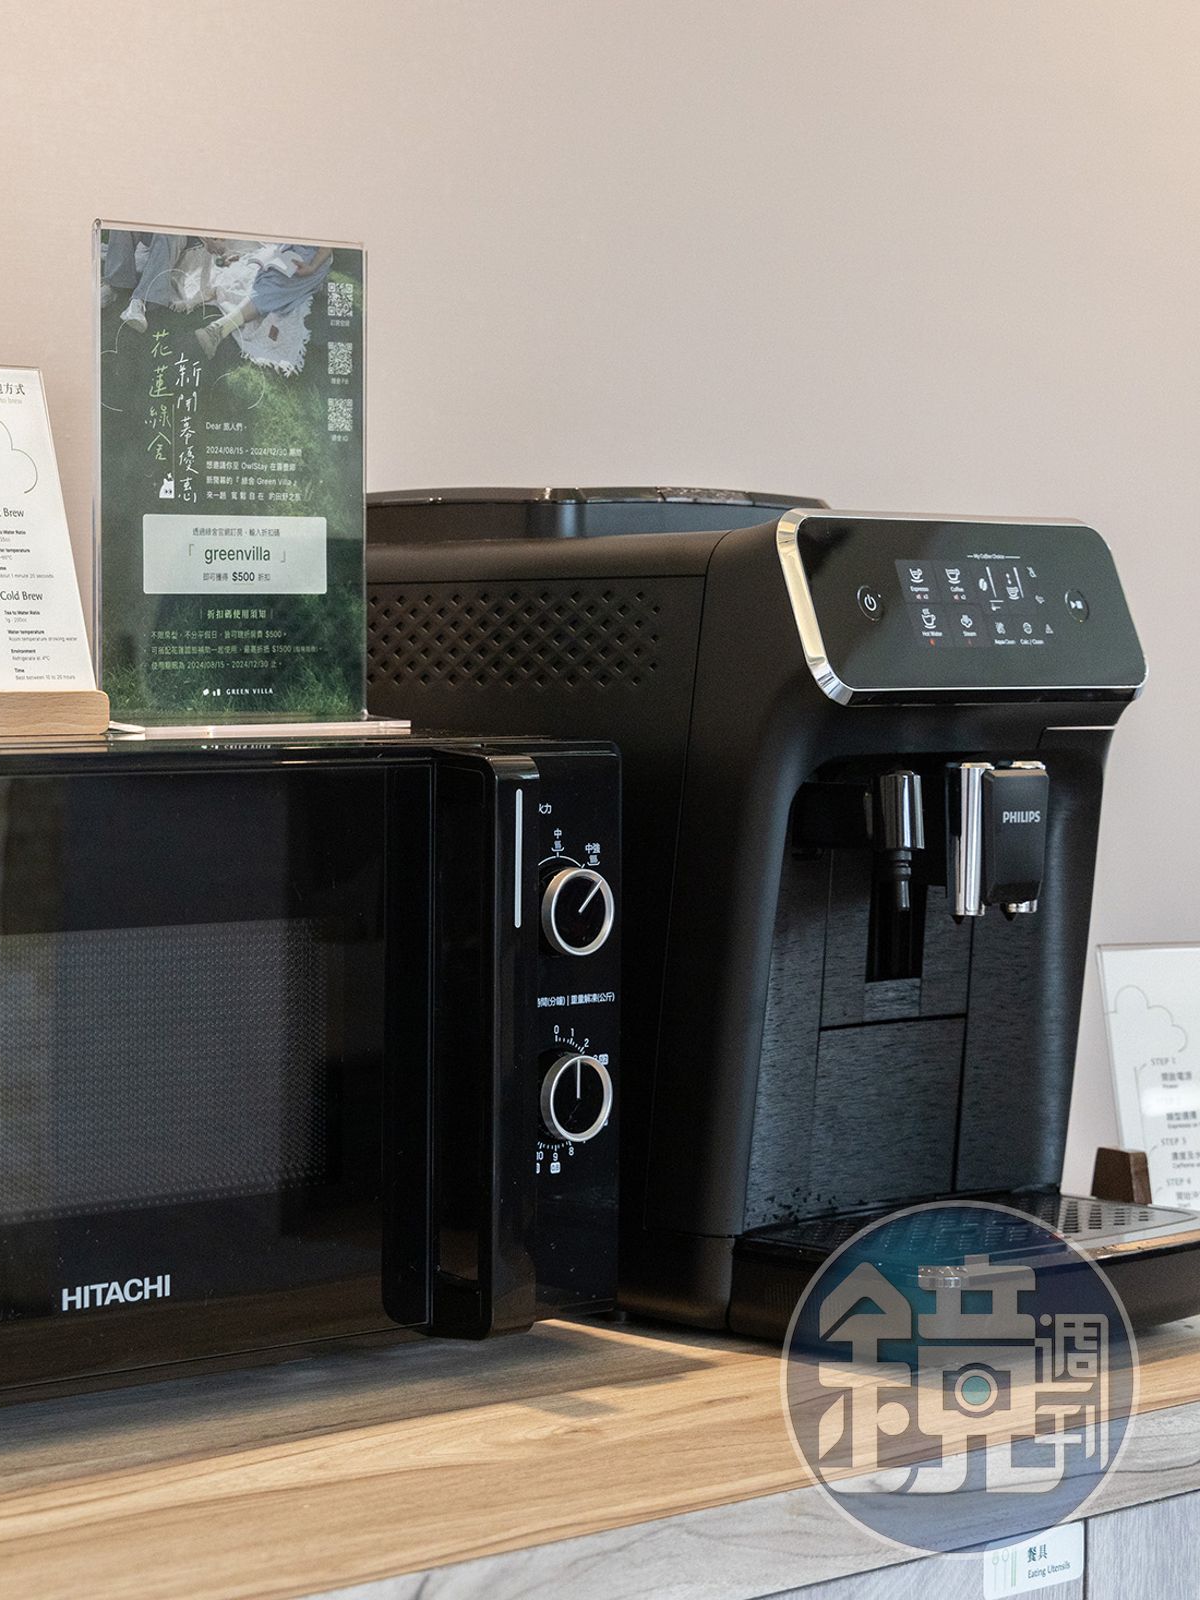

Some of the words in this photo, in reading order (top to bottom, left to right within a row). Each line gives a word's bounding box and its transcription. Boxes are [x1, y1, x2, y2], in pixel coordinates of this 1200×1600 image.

[206, 422, 221, 430] Dear
[3, 508, 24, 517] Brew
[204, 546, 271, 564] greenvilla
[231, 571, 255, 582] $500
[0, 591, 20, 601] Cold
[22, 591, 43, 601] Brew
[1002, 810, 1041, 823] PHILIPS
[554, 828, 562, 839] 中
[553, 1025, 559, 1034] 0
[570, 1028, 574, 1037] 1
[584, 1038, 590, 1048] 2
[553, 1152, 558, 1161] 9
[568, 1147, 574, 1156] 8
[62, 1274, 171, 1311] HITACHI
[1027, 1544, 1048, 1563] 餐具
[1027, 1567, 1046, 1579] Eating
[1047, 1560, 1071, 1574] Utensils
